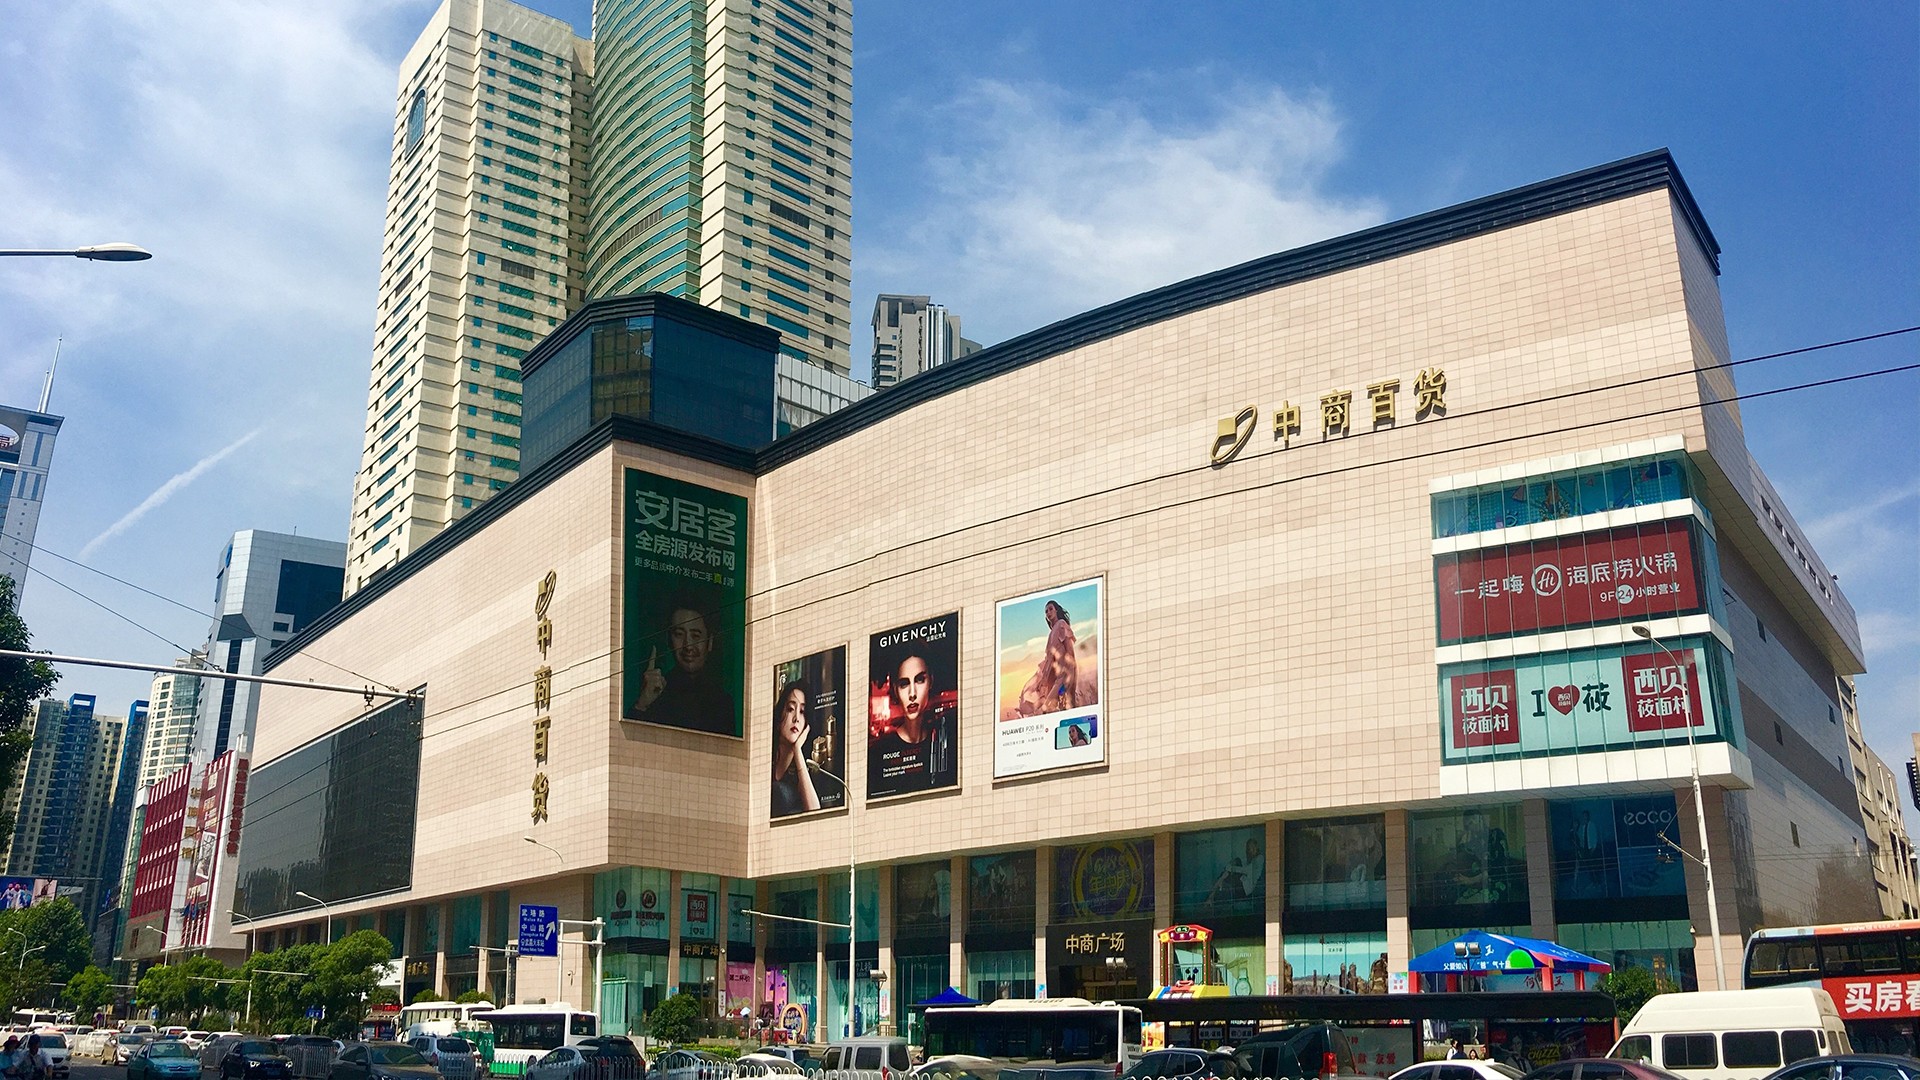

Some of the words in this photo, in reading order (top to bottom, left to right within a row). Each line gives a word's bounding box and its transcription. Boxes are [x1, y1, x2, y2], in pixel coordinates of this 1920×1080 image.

[1272, 366, 1447, 442] 中商百货
[635, 489, 737, 546] 安居客
[635, 529, 736, 571] 全房源发布网
[1566, 551, 1679, 587] 海底捞火锅
[1454, 574, 1525, 599] 一起嗨
[879, 620, 947, 648] GIVENCHY
[1632, 665, 1689, 696] 西贝
[1460, 684, 1509, 714] 西贝
[1530, 689, 1546, 718] I
[1581, 682, 1612, 713] 莜
[530, 614, 552, 824] 中商百货
[1001, 726, 1025, 737] HUAWEI
[1462, 713, 1510, 736] 莜面村
[1623, 810, 1672, 826] ecco
[683, 943, 719, 957] 中商广场
[1065, 932, 1126, 955] 中商广场
